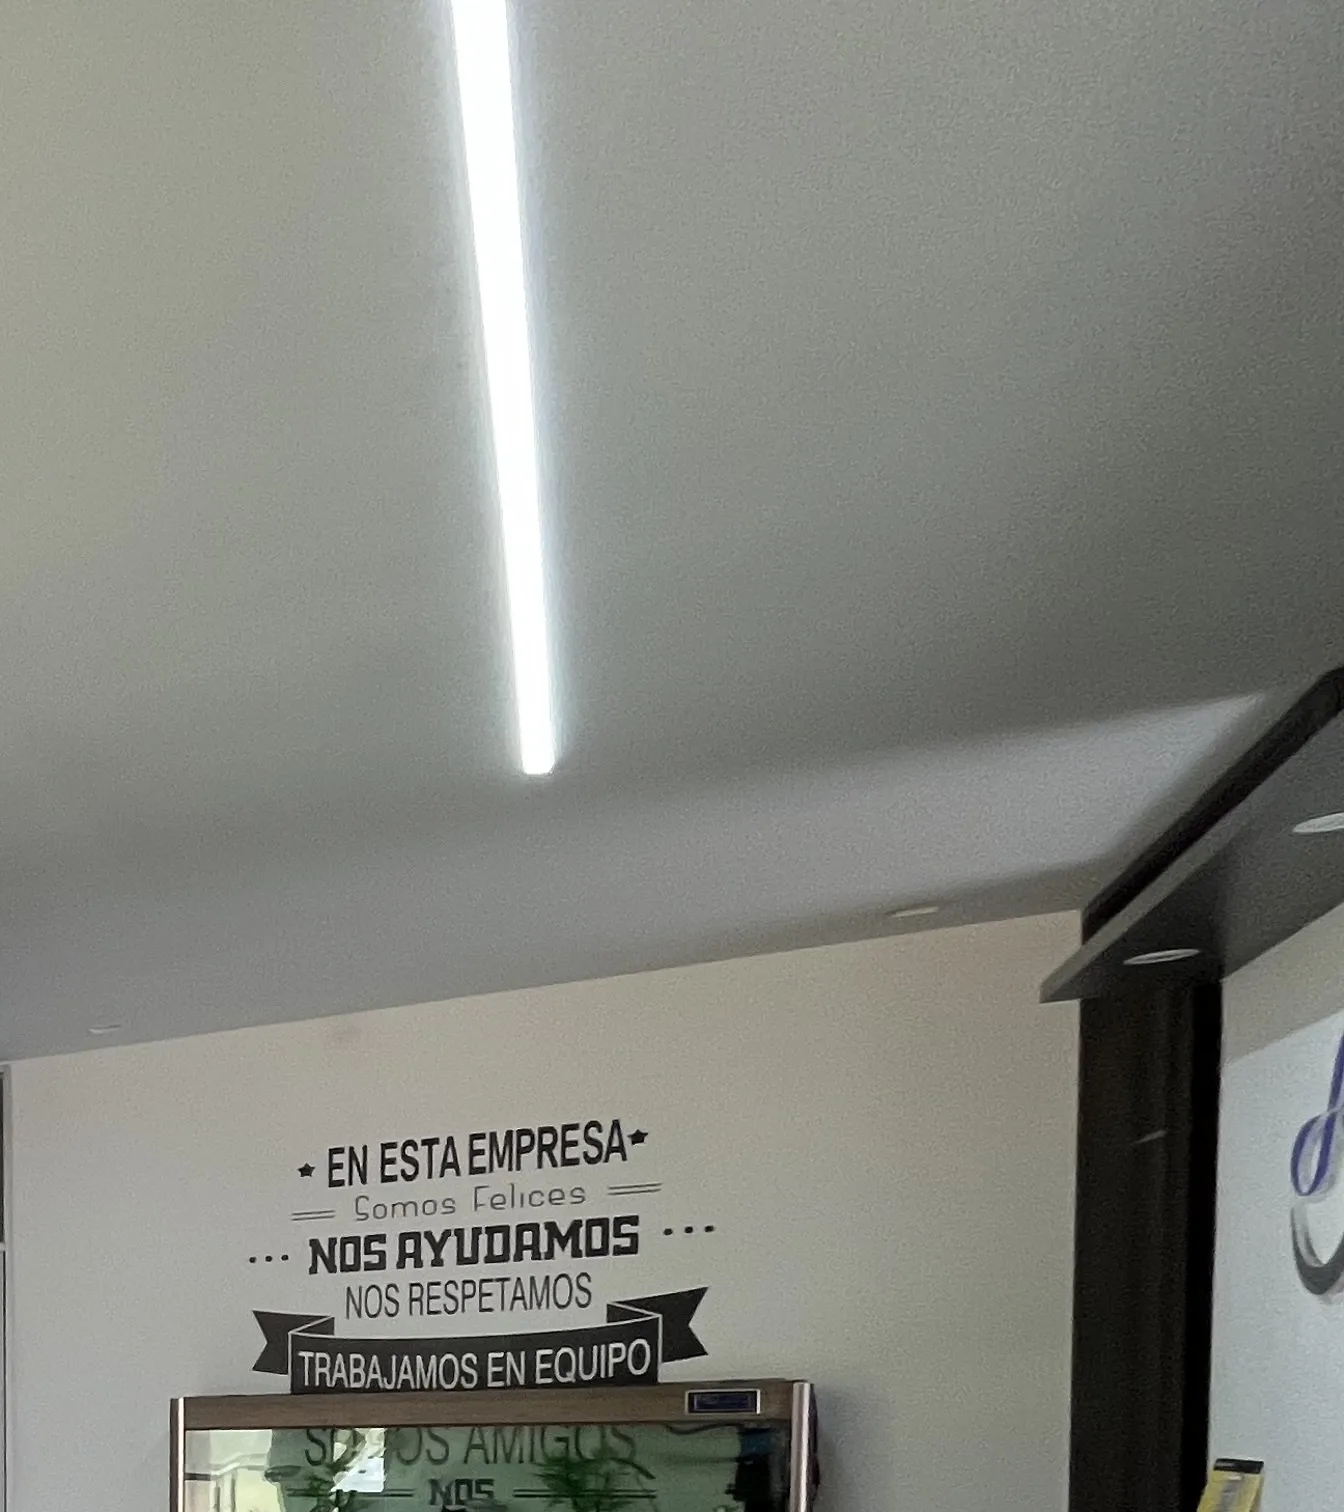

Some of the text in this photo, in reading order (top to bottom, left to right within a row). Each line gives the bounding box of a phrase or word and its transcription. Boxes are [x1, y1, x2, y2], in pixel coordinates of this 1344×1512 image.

[328, 1119, 628, 1188] EN ESTA EMPRESA
[355, 1183, 586, 1221] Somos Felices
[309, 1215, 639, 1275] NOS AYUDAMOS
[346, 1272, 592, 1319] NOS RESPETAMOS
[298, 1338, 651, 1390] TRABAJAMOS EN EQUIPO
[429, 1478, 494, 1506] NOS
